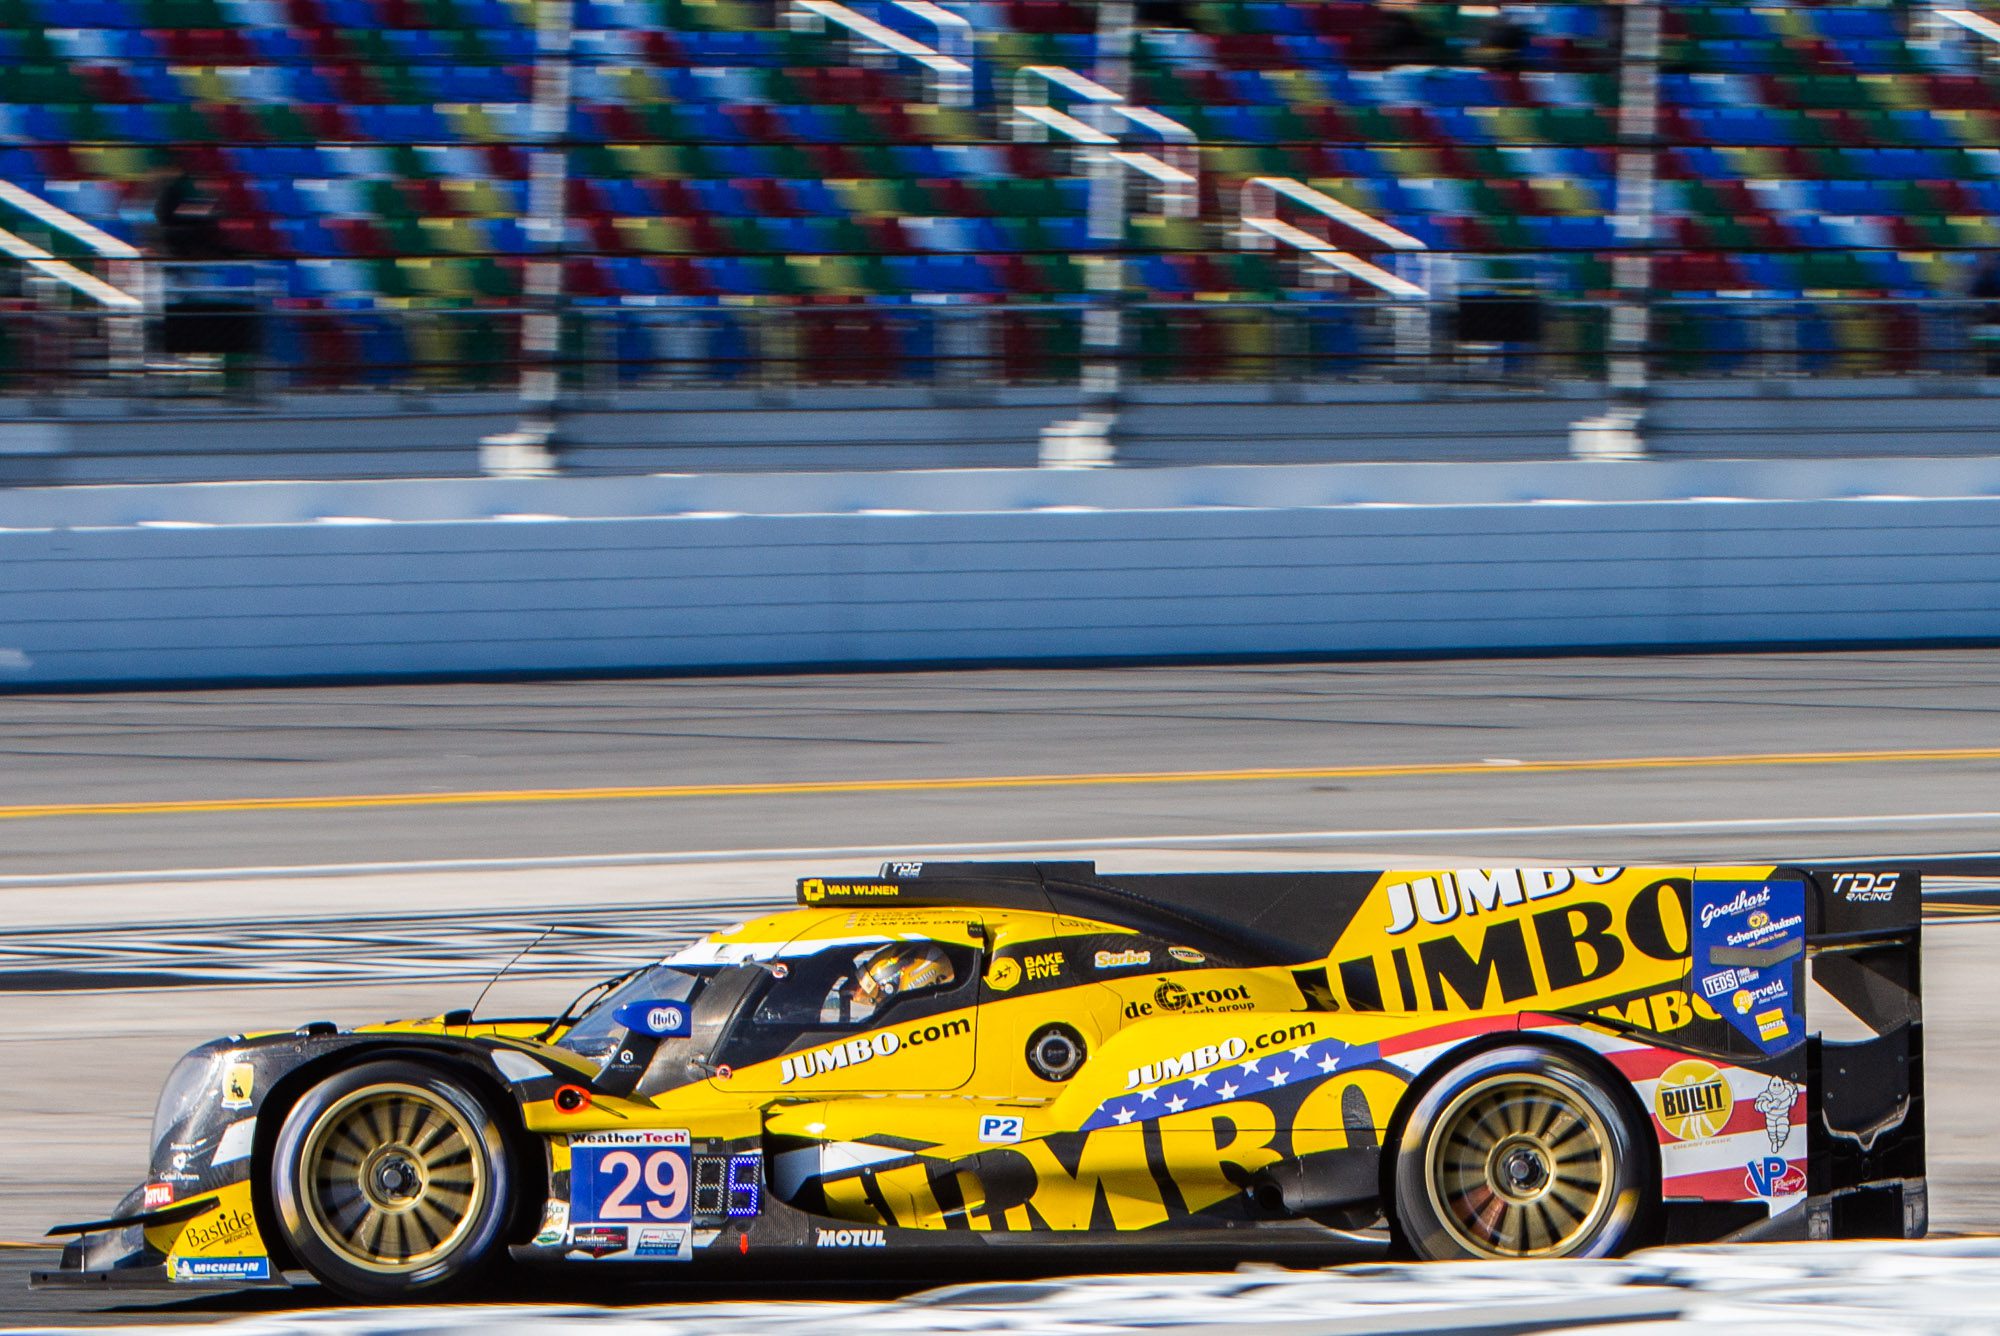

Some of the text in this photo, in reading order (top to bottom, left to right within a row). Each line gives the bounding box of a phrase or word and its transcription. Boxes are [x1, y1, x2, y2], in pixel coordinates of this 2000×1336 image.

[827, 885, 899, 895] VAN WIJNEN
[1832, 872, 1900, 893] TDS
[1846, 892, 1893, 901] RACING
[1701, 886, 1770, 929] Goedhart
[1726, 915, 1802, 946] Scherpenhuizen
[1024, 952, 1064, 968] BAKE
[1096, 951, 1149, 967] Sorbo
[1027, 965, 1061, 980] FIVE
[1125, 1002, 1153, 1019] de
[781, 1018, 970, 1085] JUMBO.com
[1124, 1021, 1316, 1090] JUMBO.com
[1662, 1083, 1723, 1117] BULLIT
[984, 1119, 1017, 1136] P2
[571, 1132, 685, 1143] WeatherTech
[599, 1151, 689, 1219] 29
[1746, 1156, 1787, 1197] VP
[728, 1157, 760, 1217] 5
[186, 1209, 252, 1247] Bastide
[817, 1230, 887, 1247] MOTUL
[194, 1263, 259, 1273] MICHELIN
